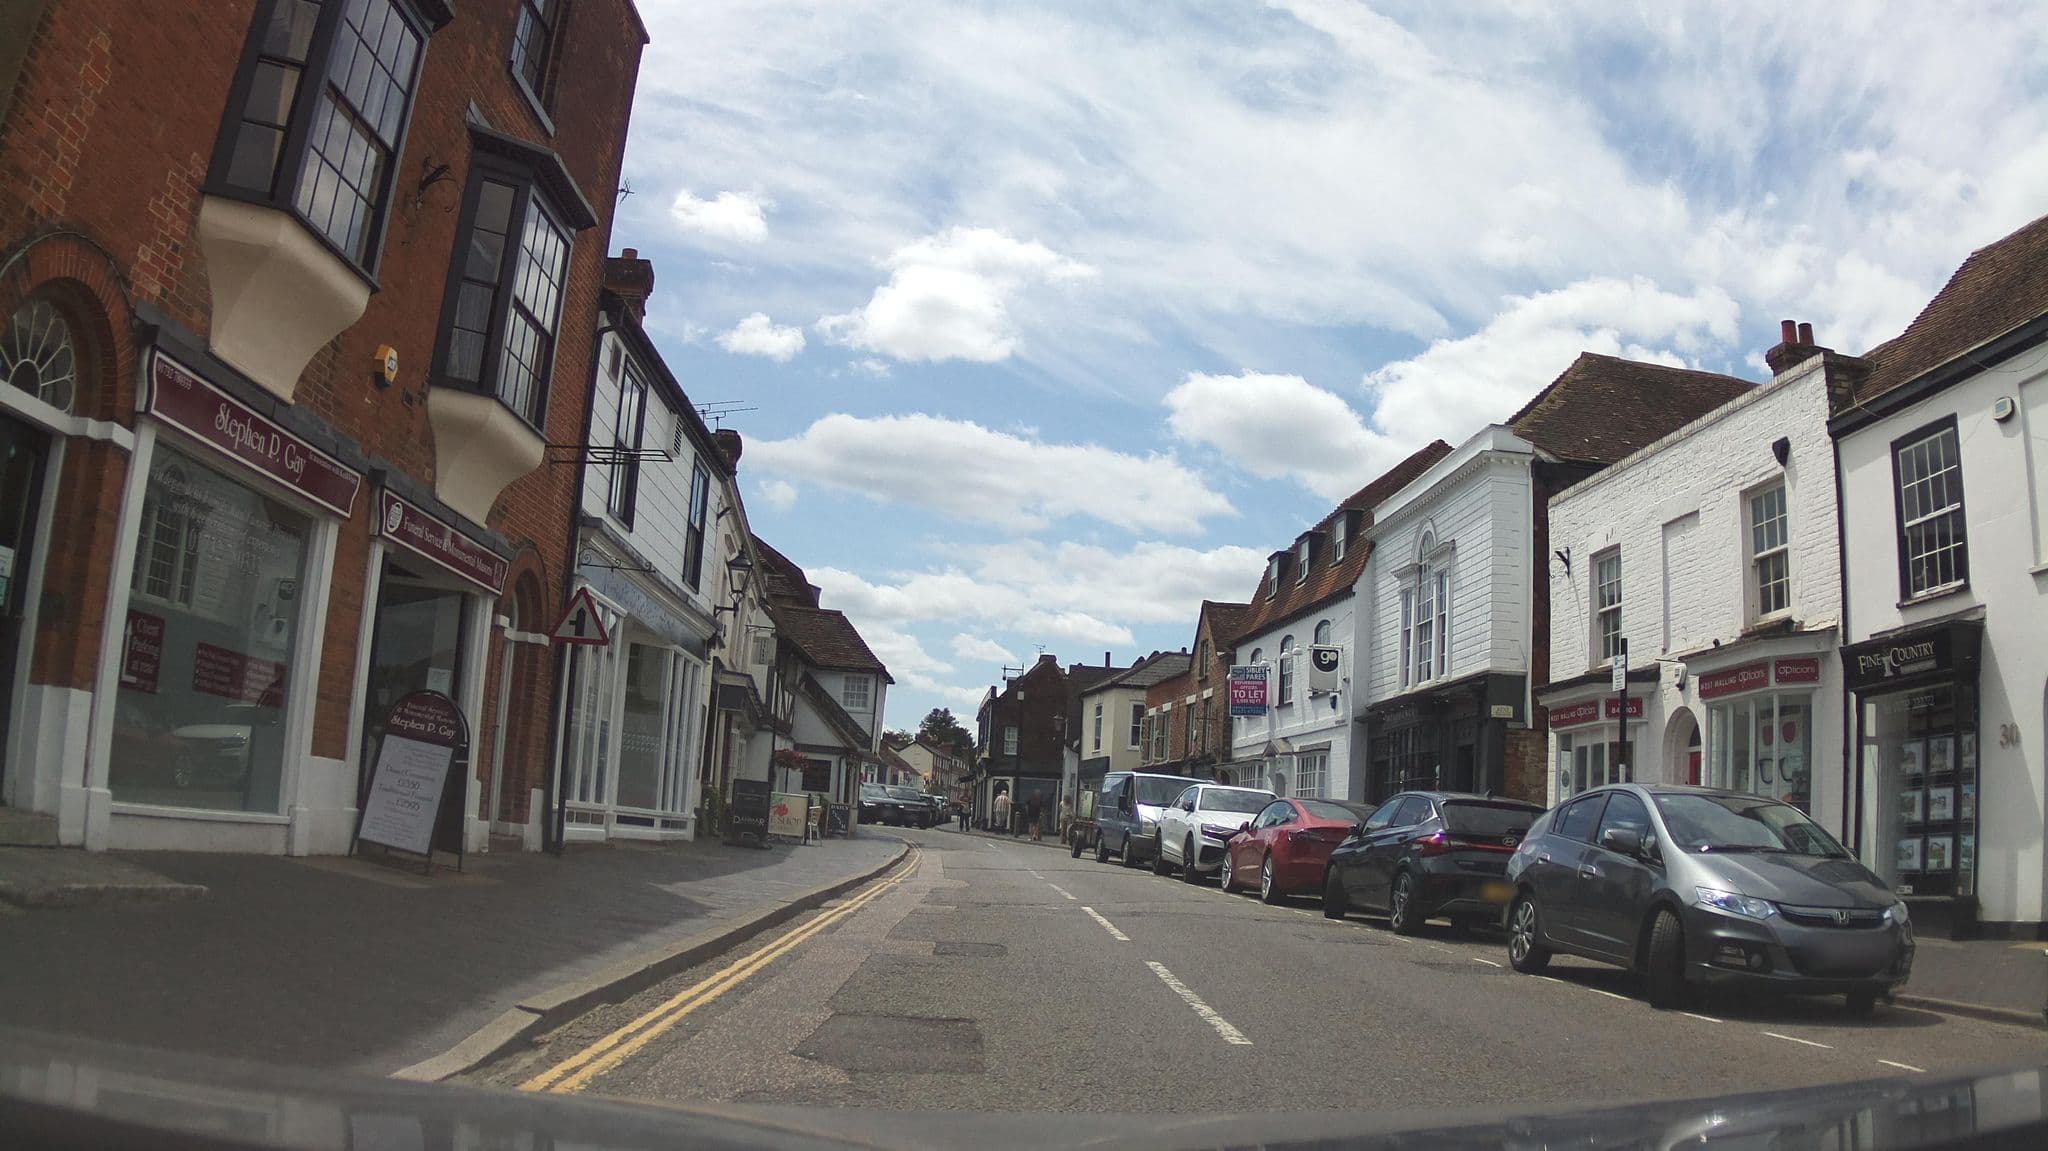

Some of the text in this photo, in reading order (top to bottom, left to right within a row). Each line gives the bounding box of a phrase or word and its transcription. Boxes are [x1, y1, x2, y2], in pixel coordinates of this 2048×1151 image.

[215, 403, 265, 450] Stephen
[285, 444, 306, 483] Gay
[403, 516, 424, 539] Funeral
[424, 527, 442, 549] Service
[1890, 641, 1935, 667] COUNTRY
[1233, 690, 1264, 699] TO LET
[1714, 676, 1737, 688] MALLING
[391, 715, 425, 730] Stephen
[439, 725, 456, 740] Gay
[2000, 723, 2020, 748] 30
